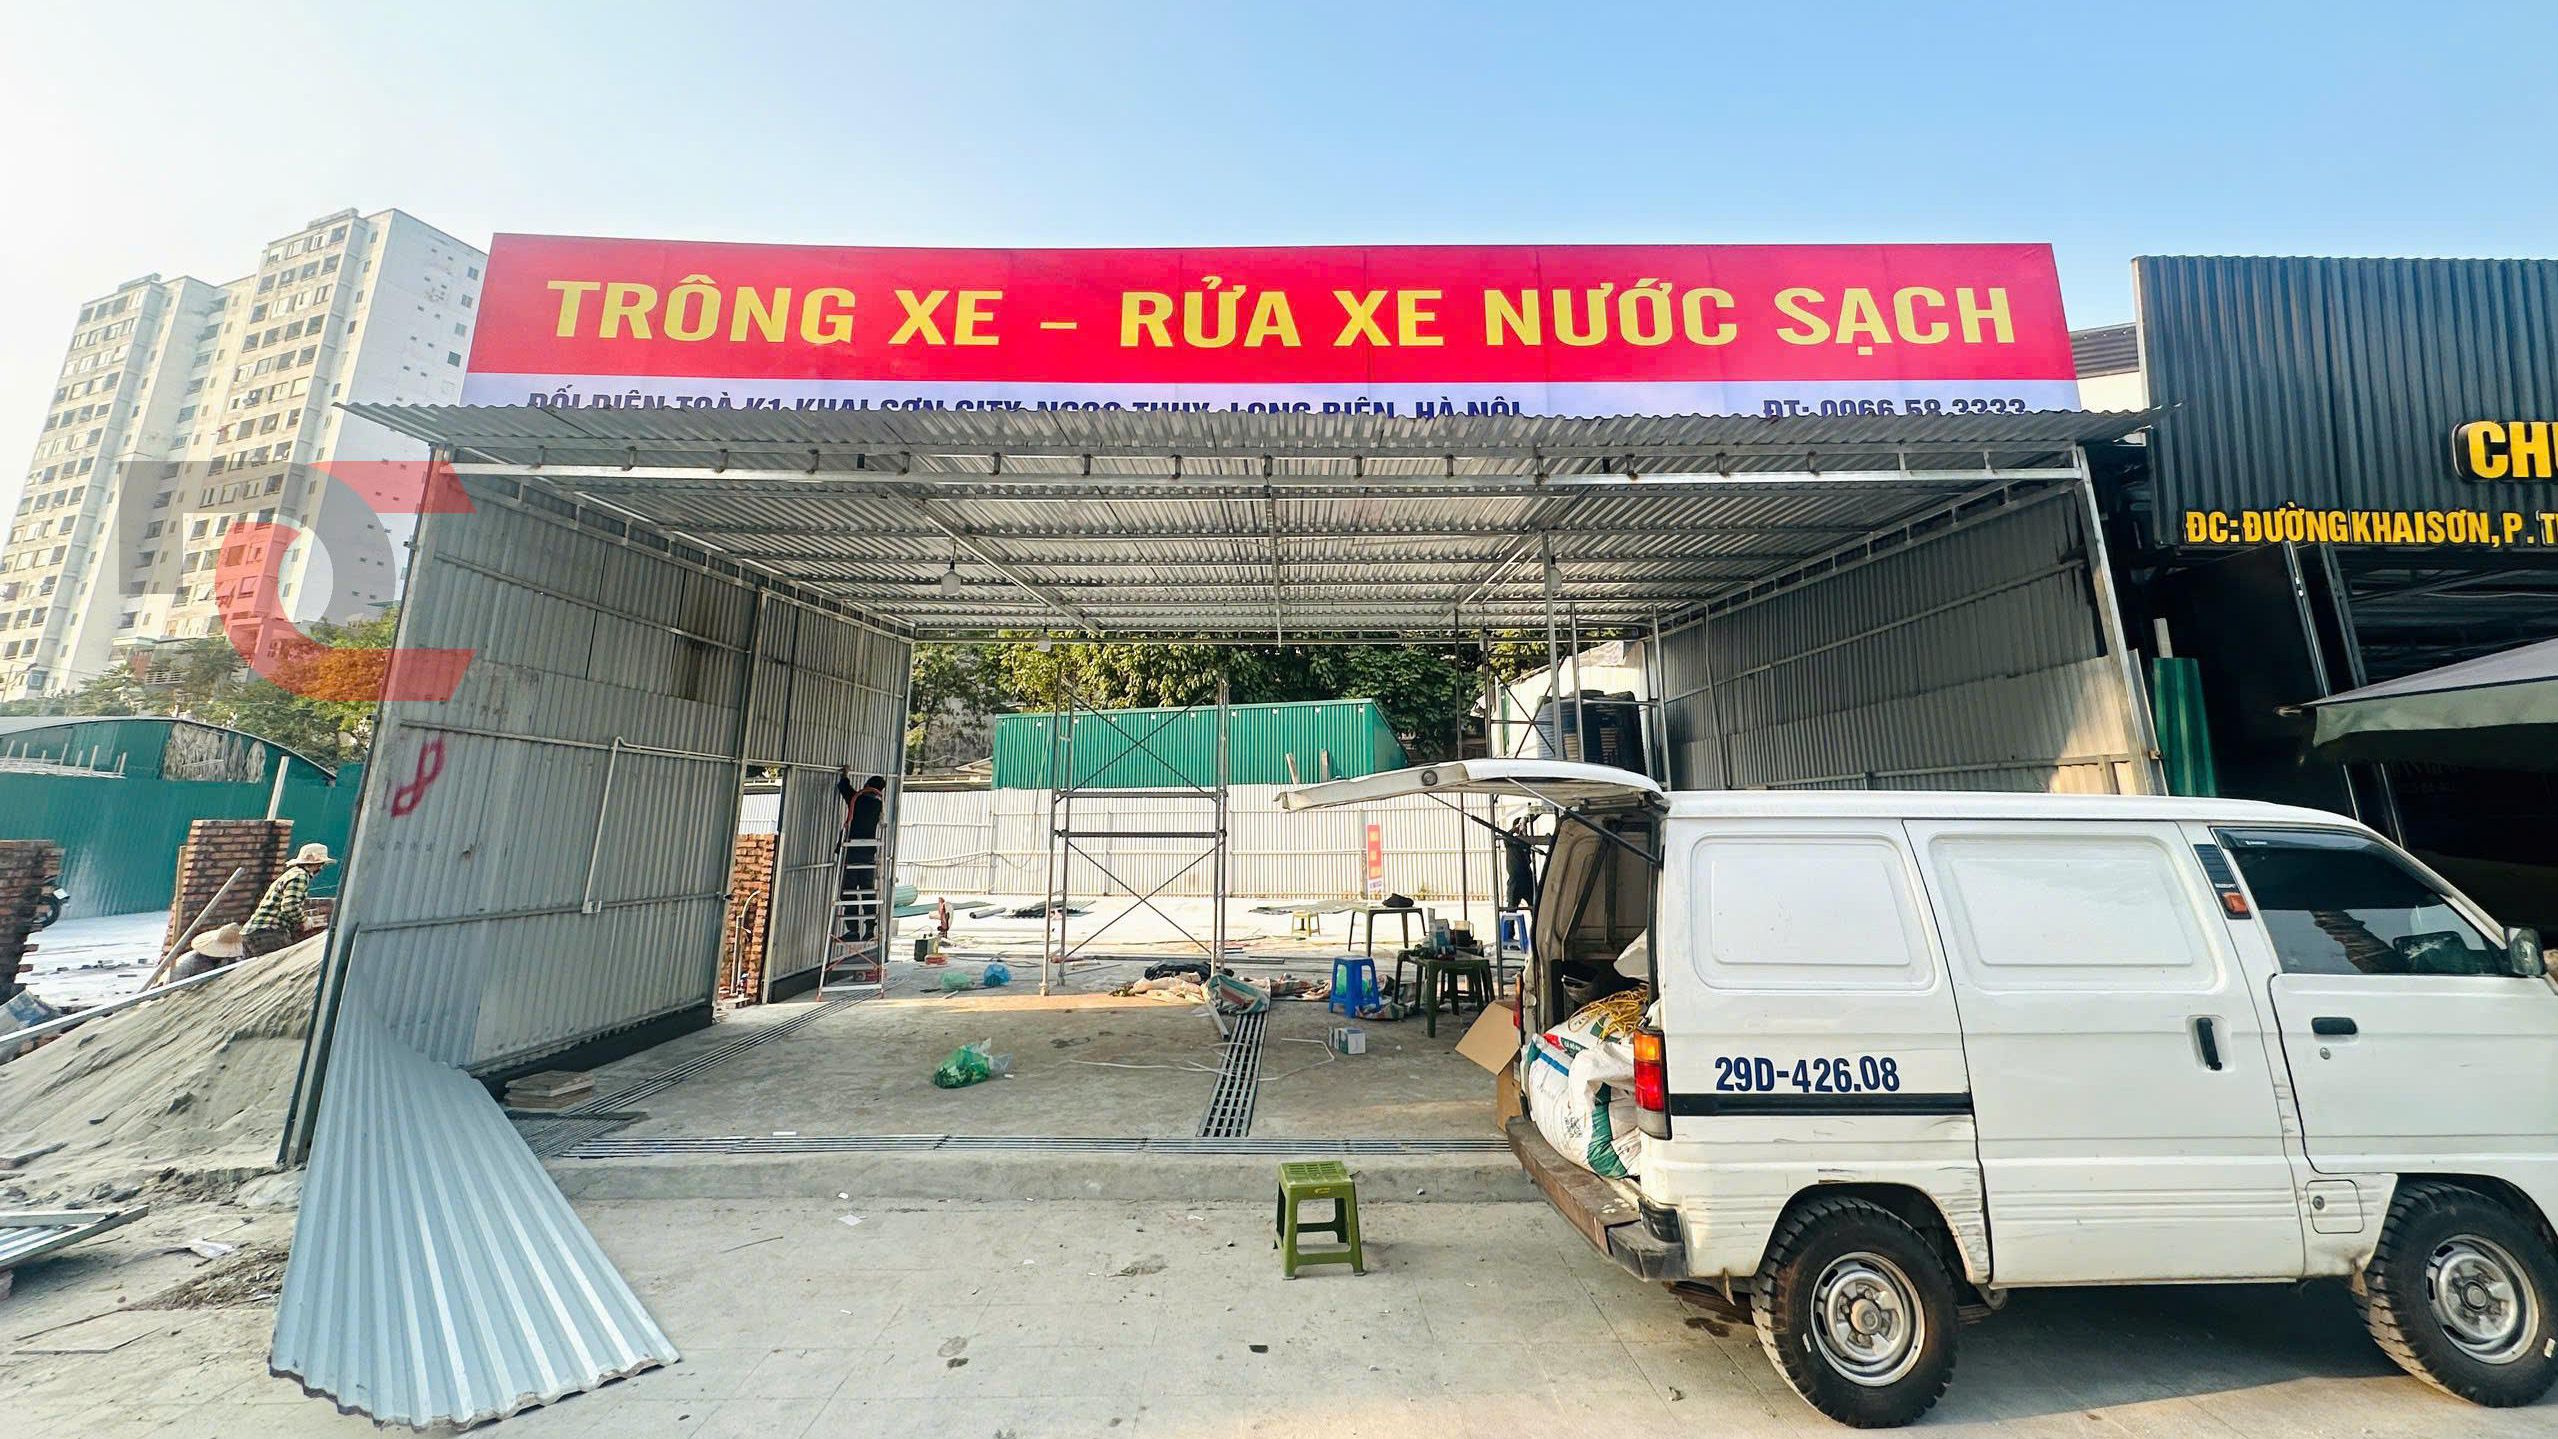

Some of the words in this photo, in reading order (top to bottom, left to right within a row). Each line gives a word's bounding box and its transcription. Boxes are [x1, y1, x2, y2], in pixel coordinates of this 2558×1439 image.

[546, 273, 856, 345] TRÔNG
[888, 290, 1002, 346] XE
[1119, 276, 1301, 348] RỬA
[1333, 289, 1445, 347] XE
[1484, 279, 1738, 347] NƯỚC
[1776, 287, 2016, 357] SẠCH
[2467, 420, 2558, 479] CH
[1714, 1055, 1901, 1094] 29D-426.08
